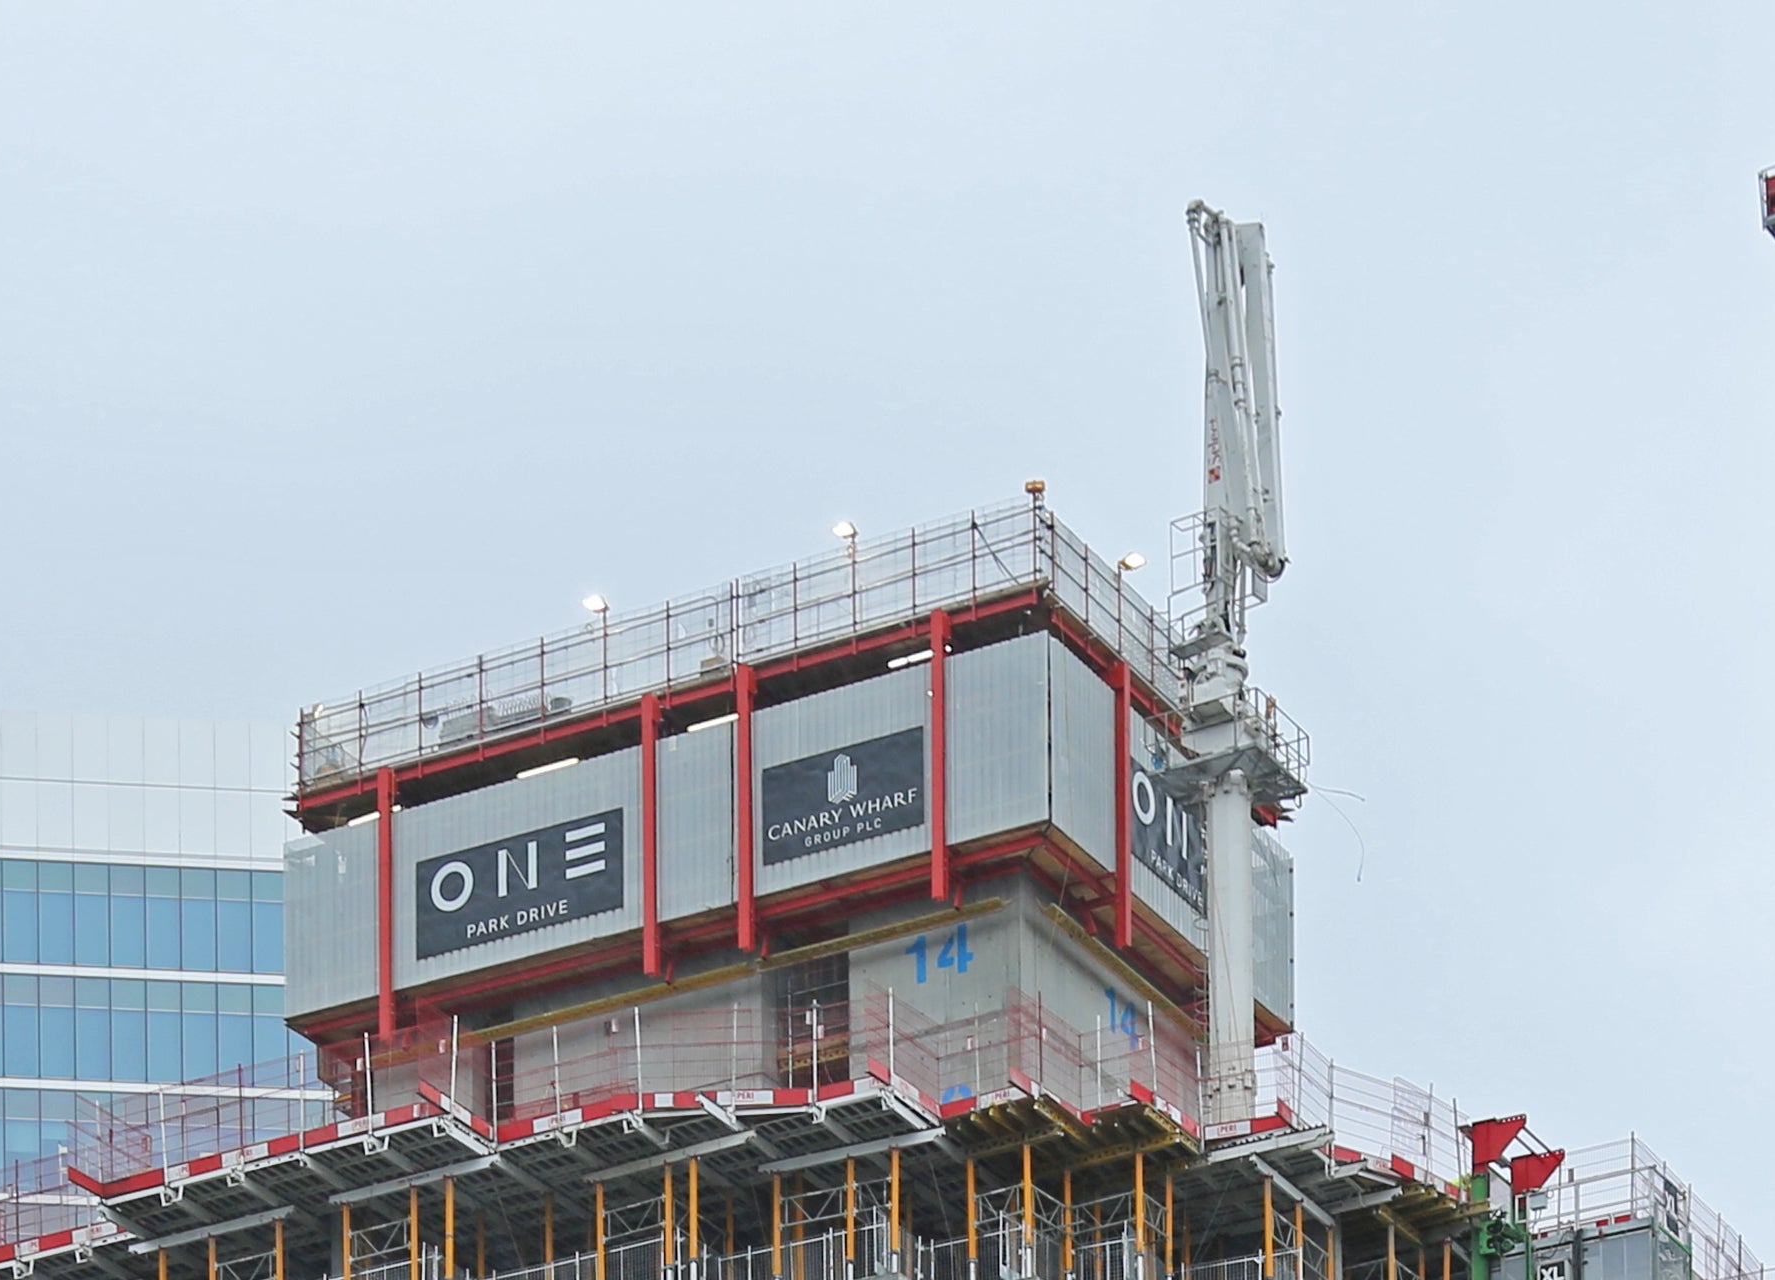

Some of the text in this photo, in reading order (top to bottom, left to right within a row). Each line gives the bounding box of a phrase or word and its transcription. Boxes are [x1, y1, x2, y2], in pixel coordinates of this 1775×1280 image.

[767, 787, 918, 841] CANARY WHARF
[804, 817, 882, 847] GROUP PLC
[430, 821, 606, 913] ONE
[1150, 850, 1204, 908] PARK DRIVE
[466, 899, 568, 938] PARK DRIVE
[905, 923, 974, 984] 14
[1105, 986, 1139, 1050] 14
[736, 1091, 755, 1101] PERI
[995, 1090, 1011, 1101] PERI
[1219, 1123, 1239, 1134] PERI
